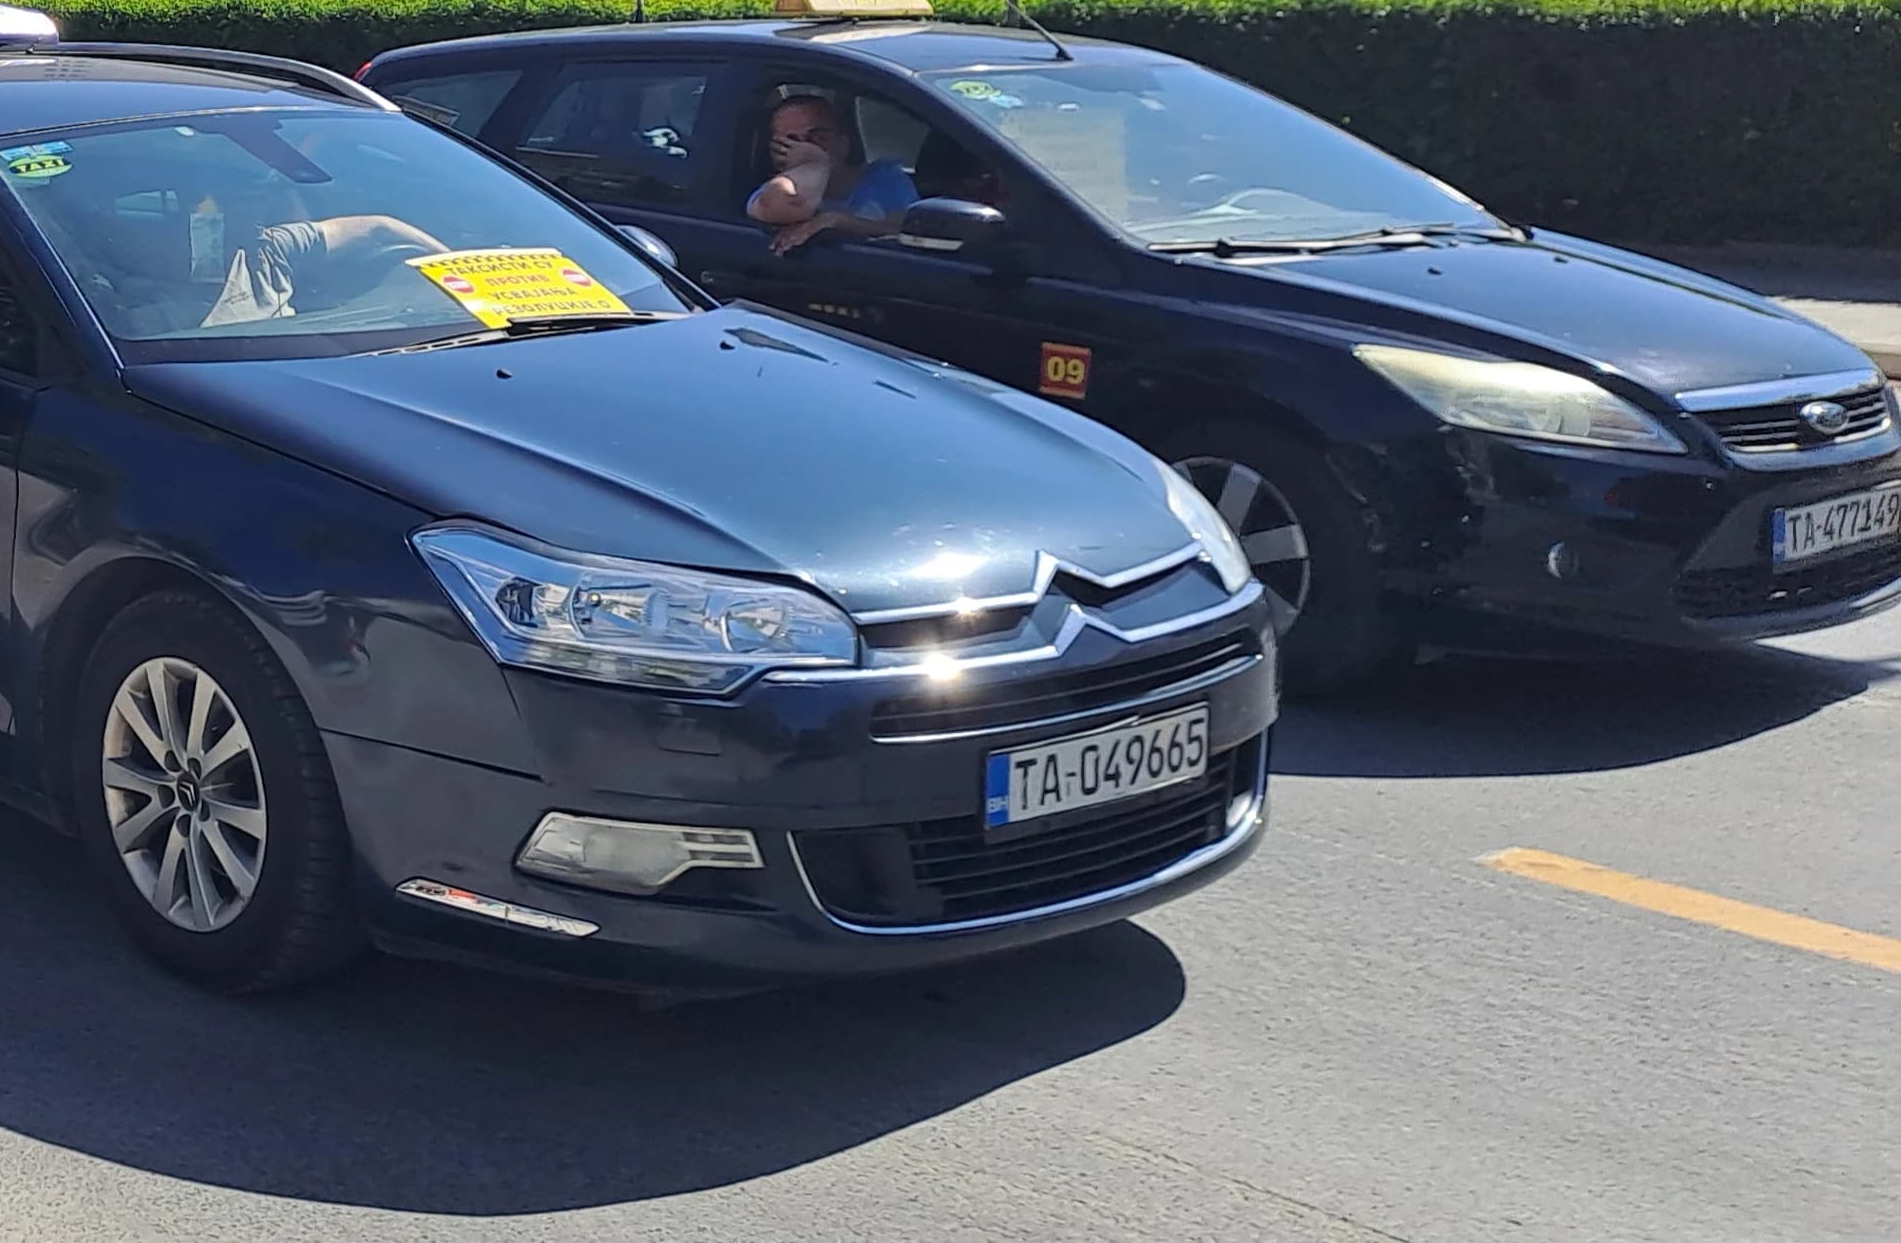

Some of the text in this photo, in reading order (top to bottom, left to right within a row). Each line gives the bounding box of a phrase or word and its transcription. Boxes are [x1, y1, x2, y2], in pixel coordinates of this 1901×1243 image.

[15, 159, 67, 173] TAXI
[444, 260, 554, 277] ТАКСИСТИ СУ
[484, 274, 551, 287] ПРОТИВ
[489, 287, 578, 301] УСВАЈАЊА
[1047, 356, 1086, 385] 09
[1788, 493, 1901, 553] TA-477149
[1014, 718, 1205, 811] TA-049665
